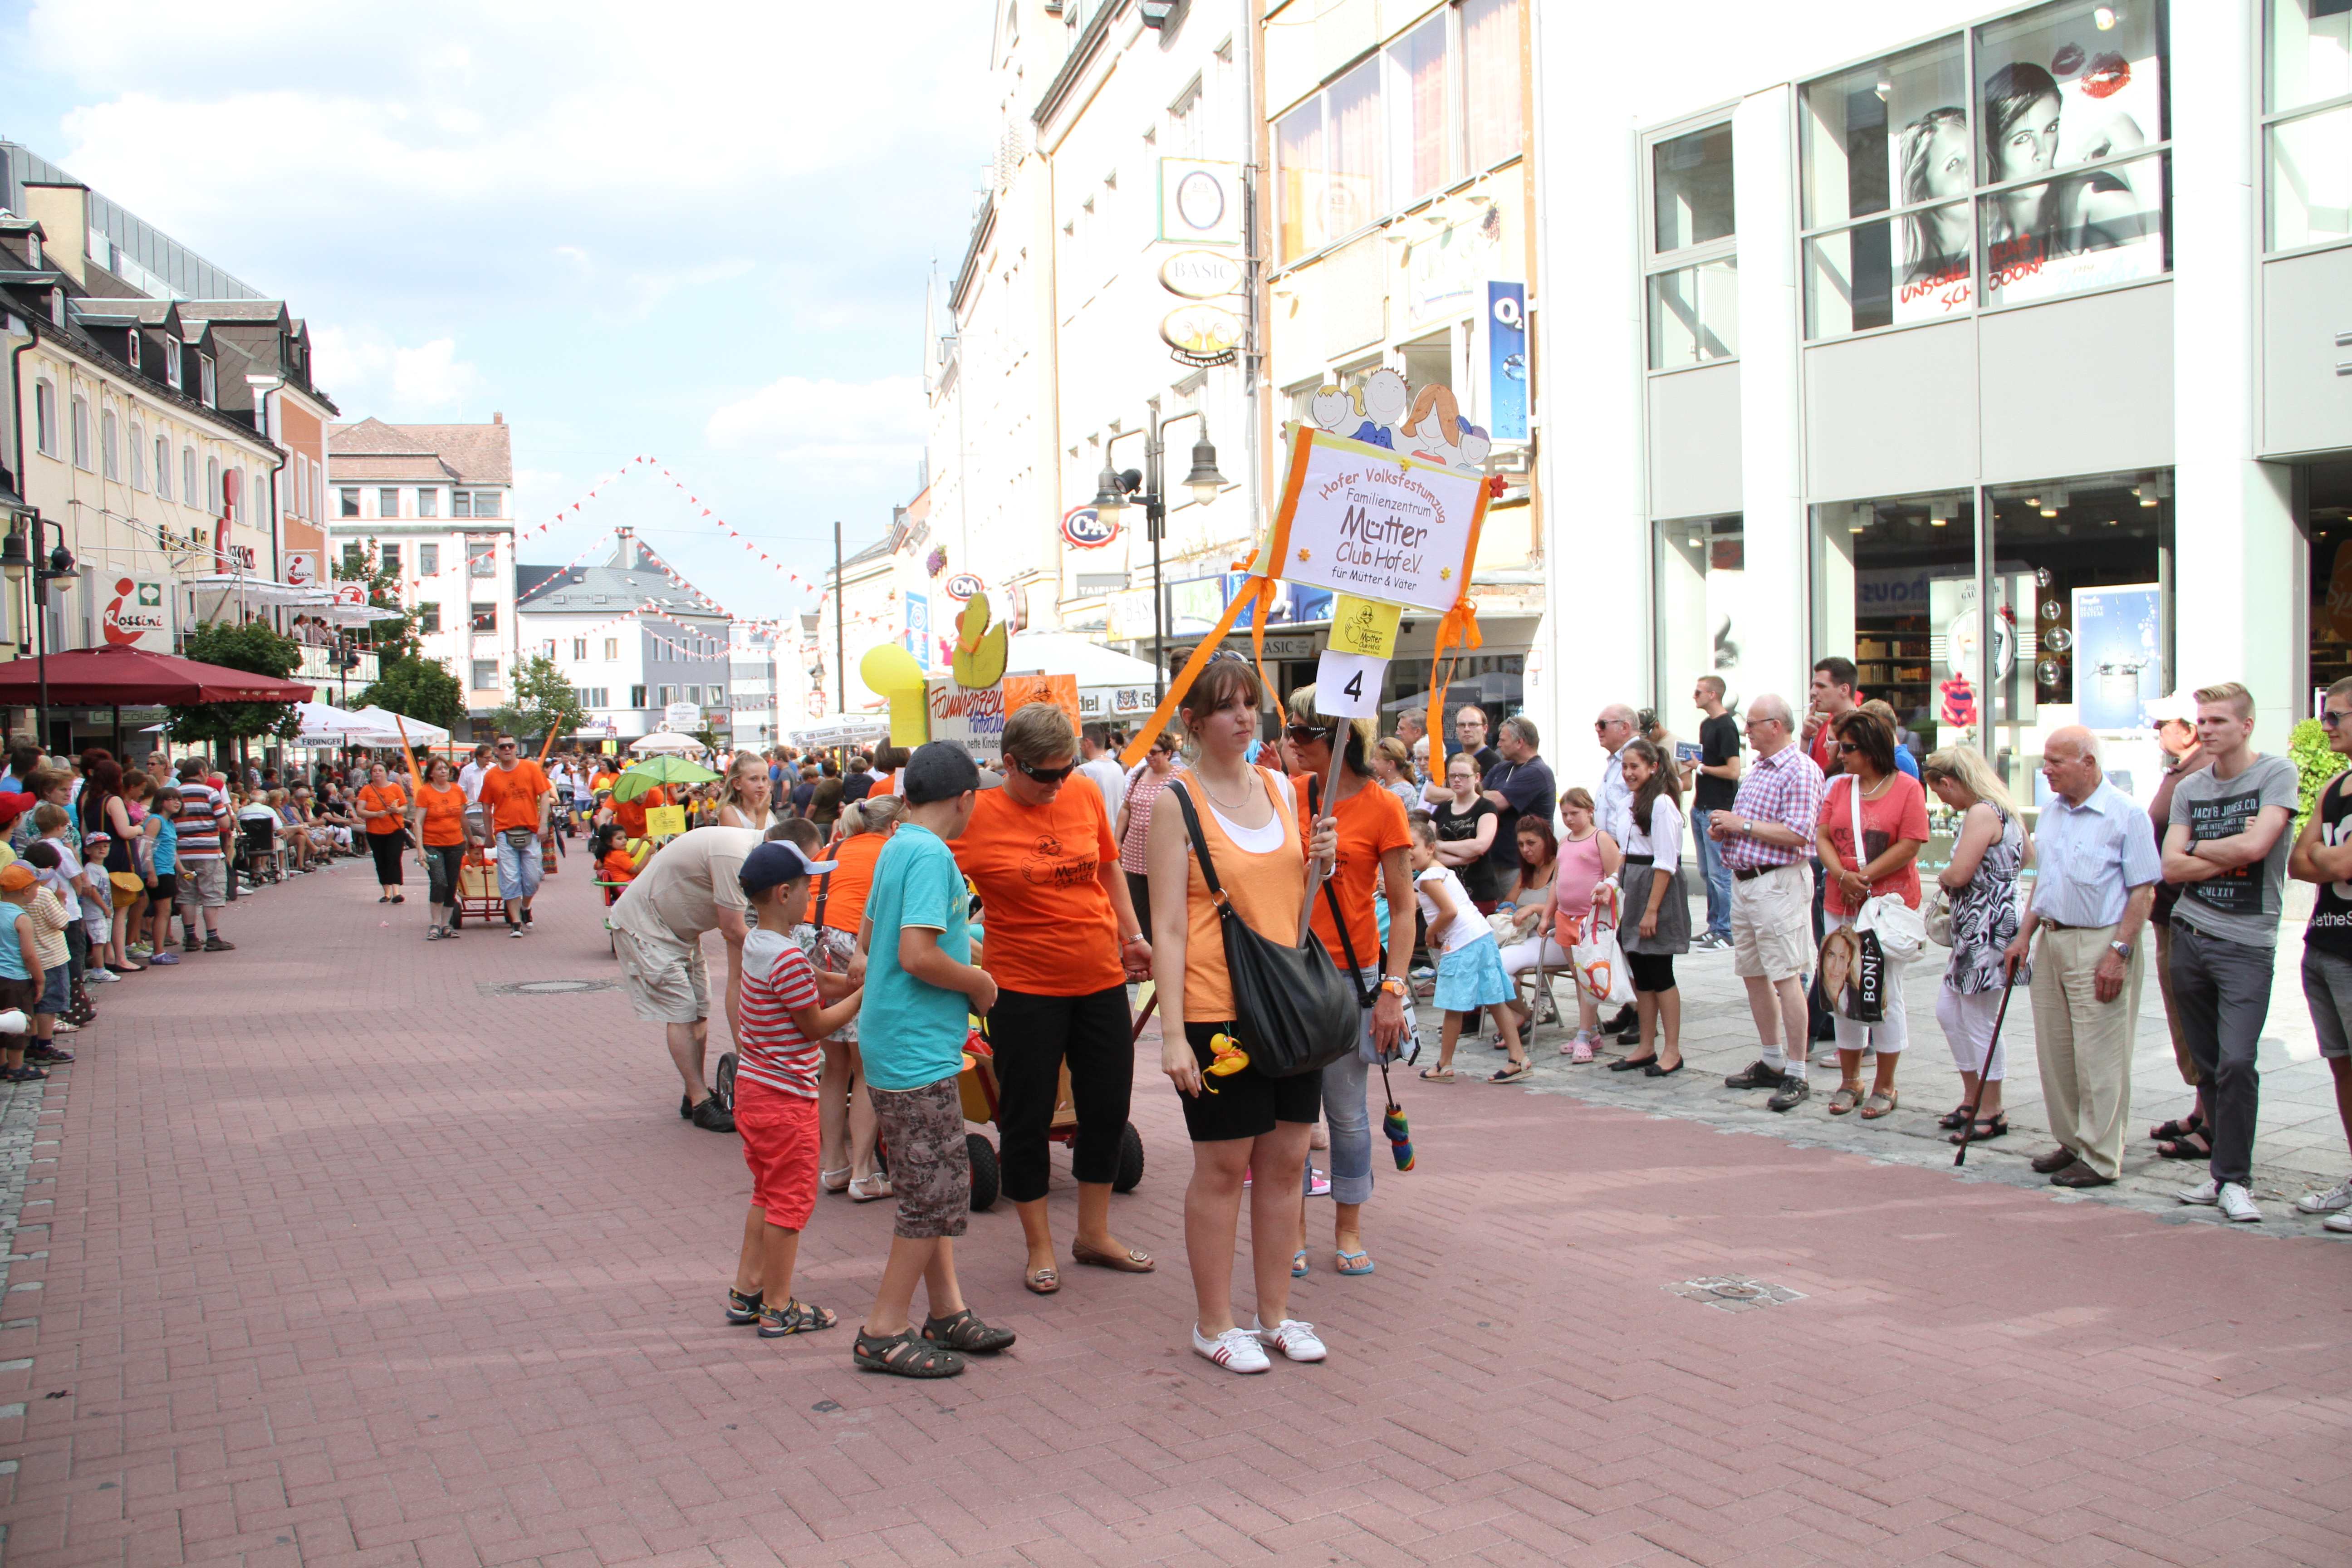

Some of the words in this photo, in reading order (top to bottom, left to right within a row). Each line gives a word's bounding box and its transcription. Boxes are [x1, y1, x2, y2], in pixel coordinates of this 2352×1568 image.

[1175, 262, 1230, 279] BASIC
[1318, 472, 1360, 500] Hofer
[1366, 468, 1446, 524] Volksfestumzug
[1346, 487, 1431, 517] Familienzentrum
[1072, 515, 1109, 537] C&A
[1340, 505, 1427, 549] Mütter
[1336, 541, 1372, 565] Club
[1374, 547, 1403, 573] Hof
[1402, 553, 1423, 574] e.V.
[1332, 566, 1347, 578] für
[1349, 569, 1382, 584] Mütter
[1384, 576, 1390, 587] &
[1394, 577, 1417, 591] Väter
[105, 609, 163, 627] Rossini
[1126, 594, 1153, 622] BASI
[1263, 641, 1293, 653] ASIC
[1344, 670, 1363, 702] 4
[302, 738, 342, 746] ERDINGER
[967, 738, 980, 749] nette
[2213, 806, 2219, 817] &
[2221, 825, 2244, 834] COMPAN
